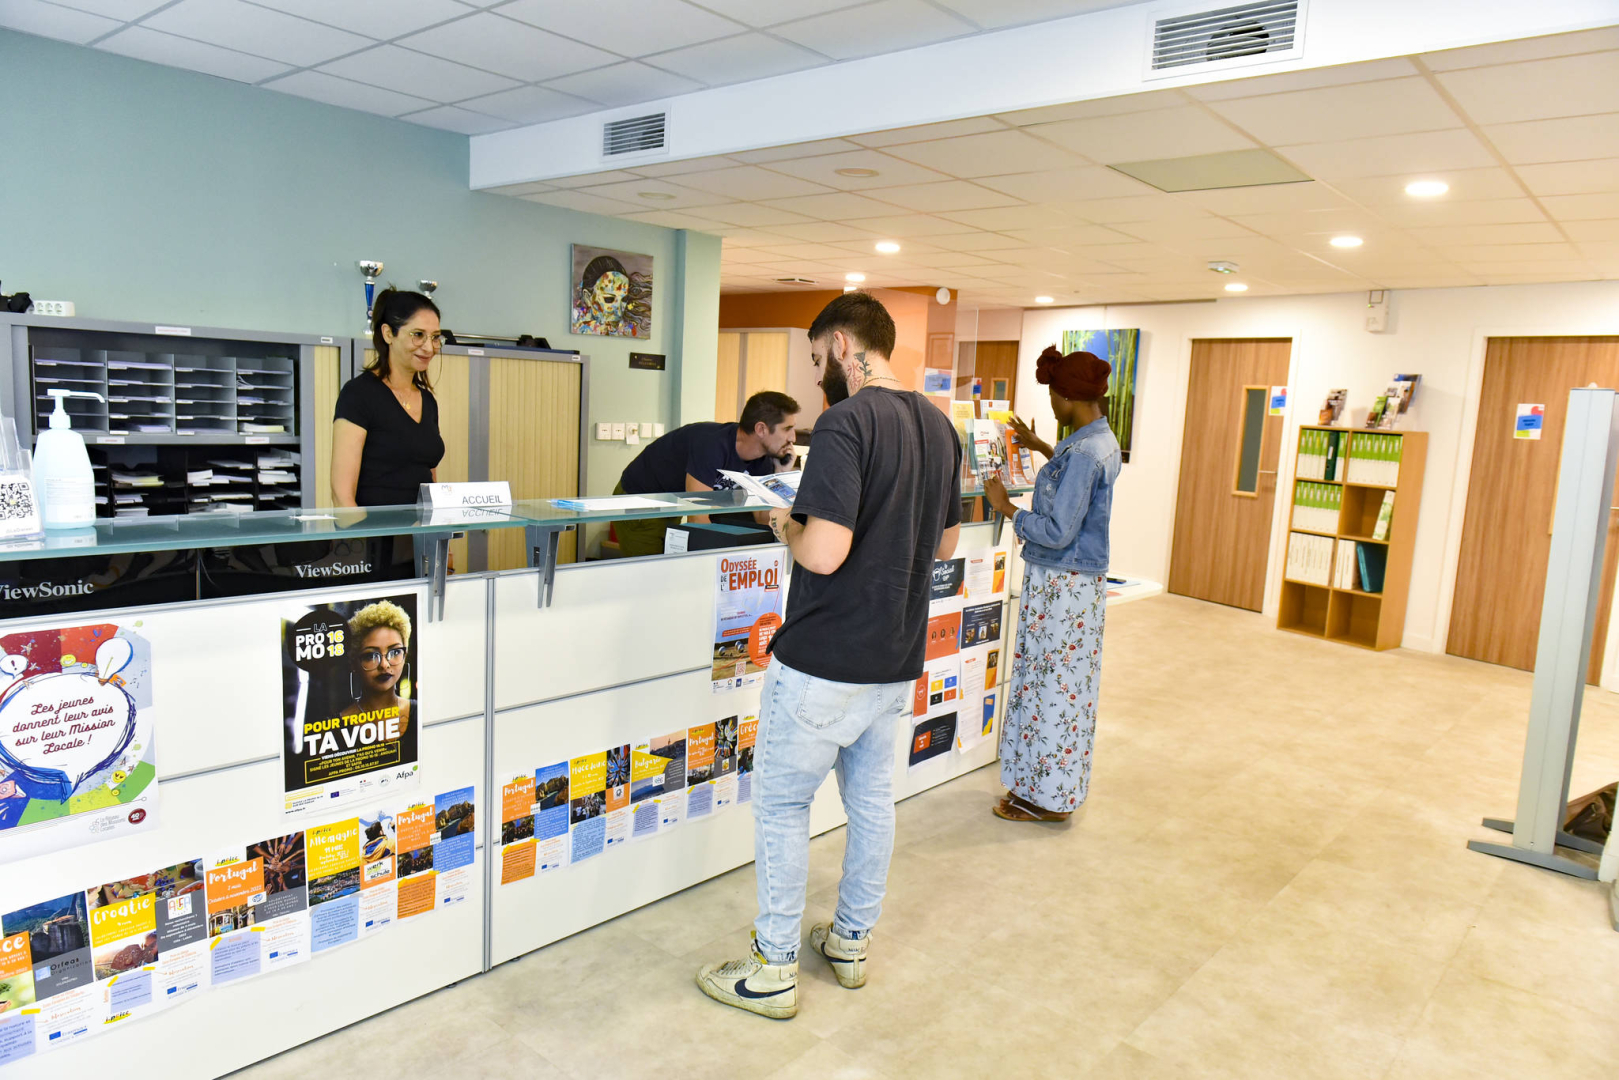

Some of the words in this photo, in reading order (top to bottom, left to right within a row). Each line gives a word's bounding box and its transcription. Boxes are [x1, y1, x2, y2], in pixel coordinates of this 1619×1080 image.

[462, 495, 503, 505] ACCUEIL
[294, 560, 373, 580] ViewSonic
[720, 558, 757, 574] ODYSSÉE
[313, 622, 327, 632] LA
[295, 632, 324, 647] PRO
[327, 630, 344, 644] 16
[296, 644, 325, 662] MO
[327, 642, 344, 658] 18
[30, 703, 54, 716] Les
[54, 696, 94, 715] jeunes
[12, 714, 60, 733] donnent
[64, 711, 88, 723] leur
[91, 705, 114, 718] avis
[304, 717, 341, 735] POUR
[342, 706, 400, 727] TROUVER
[740, 722, 758, 735] Grèc
[15, 735, 38, 747] sur
[40, 728, 66, 742] leur
[69, 718, 116, 736] Mission
[304, 730, 340, 757] TA
[341, 718, 400, 748] VOIE
[43, 738, 85, 755] Locale
[87, 734, 92, 745] !
[395, 768, 414, 781] Afpa
[504, 780, 534, 797] Portugal
[398, 806, 434, 826] Portugal
[309, 828, 358, 848] Allemagne
[209, 860, 258, 884] Portugal
[367, 861, 384, 870] werk
[370, 869, 390, 879] schule
[94, 898, 151, 926] Croatie
[2, 935, 26, 954] ce
[50, 957, 80, 970] Orfeas
